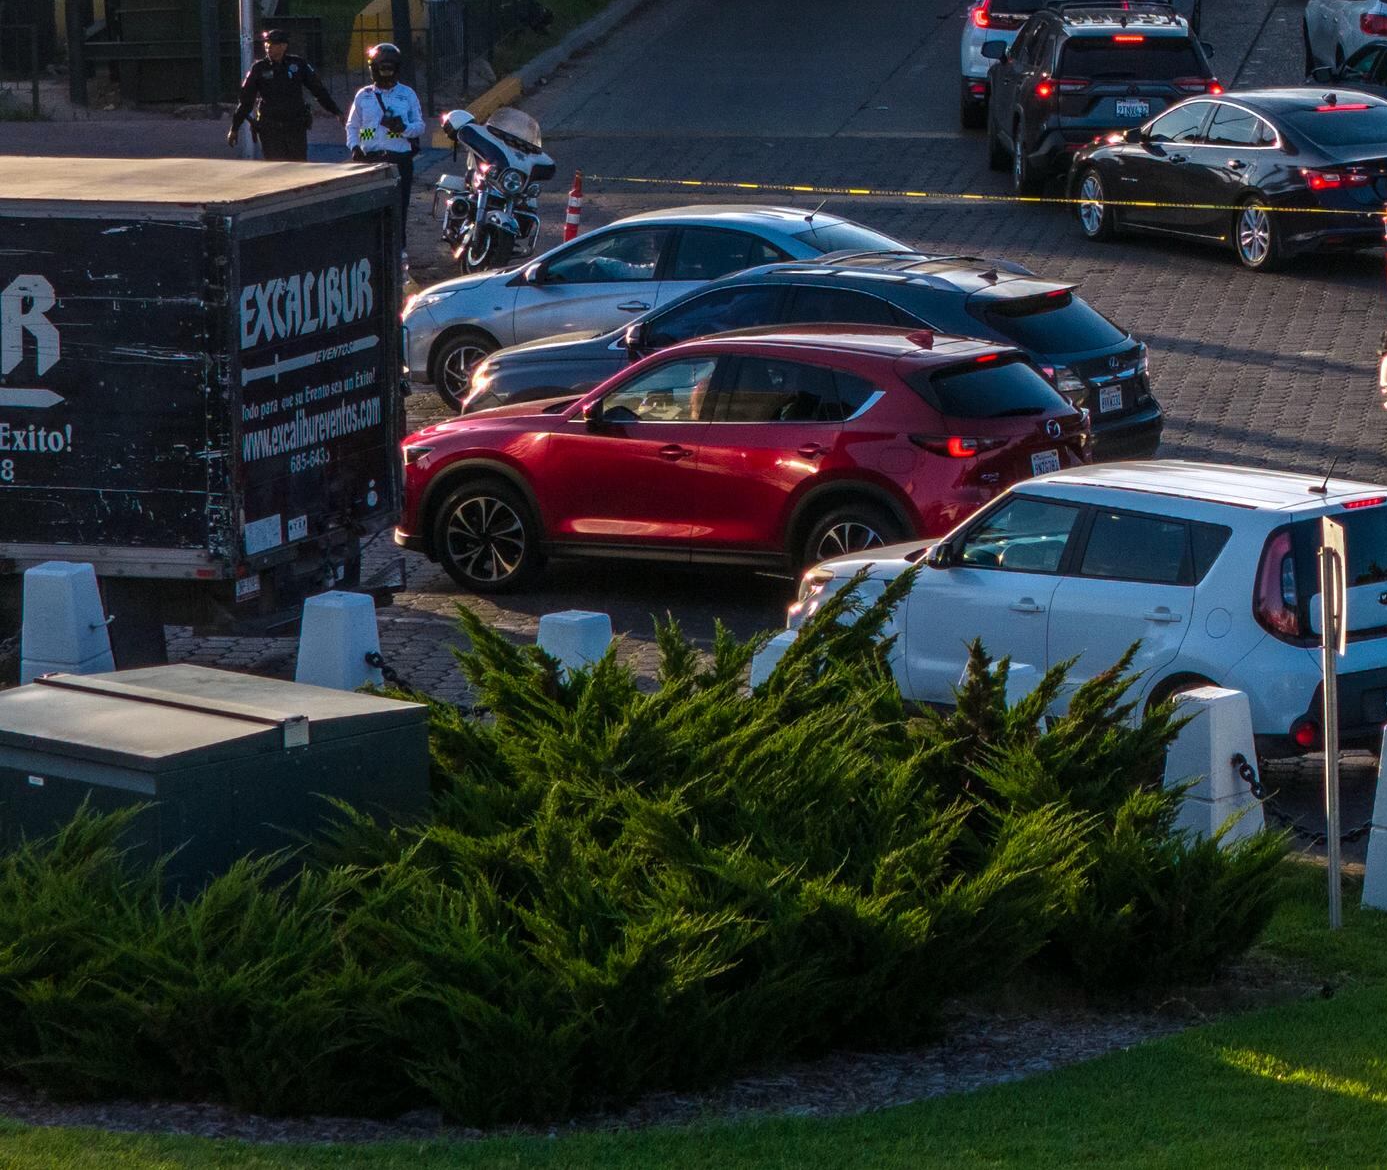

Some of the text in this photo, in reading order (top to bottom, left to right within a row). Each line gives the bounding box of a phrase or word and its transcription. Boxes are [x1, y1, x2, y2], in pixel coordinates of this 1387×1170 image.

[1, 274, 61, 376] R
[240, 258, 373, 350] EXCALIBUR
[316, 341, 354, 363] EVENTOS
[242, 367, 376, 422] Todo para que su Evento sea un Exito!
[0, 423, 73, 452] Exito!
[242, 396, 381, 462] www.excalibureventos.com
